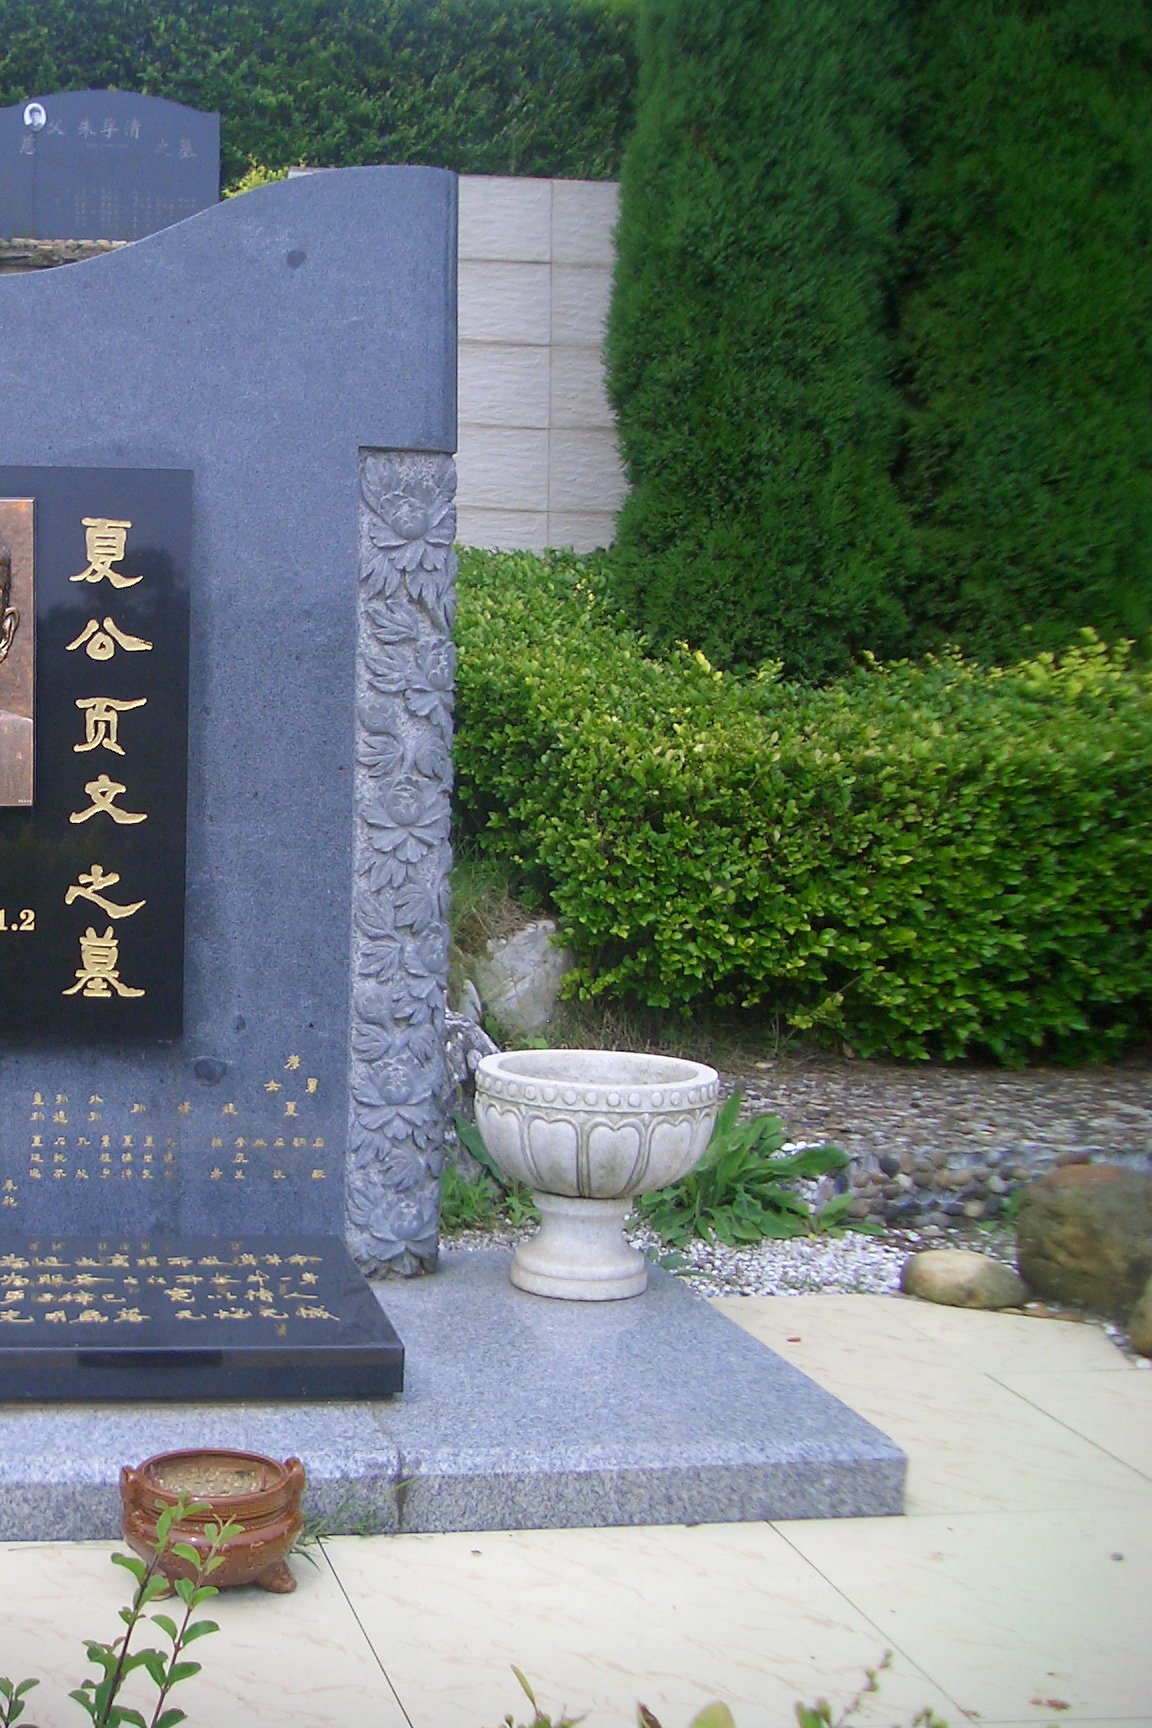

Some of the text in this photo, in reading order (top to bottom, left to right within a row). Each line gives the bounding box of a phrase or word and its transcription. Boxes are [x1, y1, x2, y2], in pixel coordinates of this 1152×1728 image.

[63, 516, 153, 999] 夏公页文之墓
